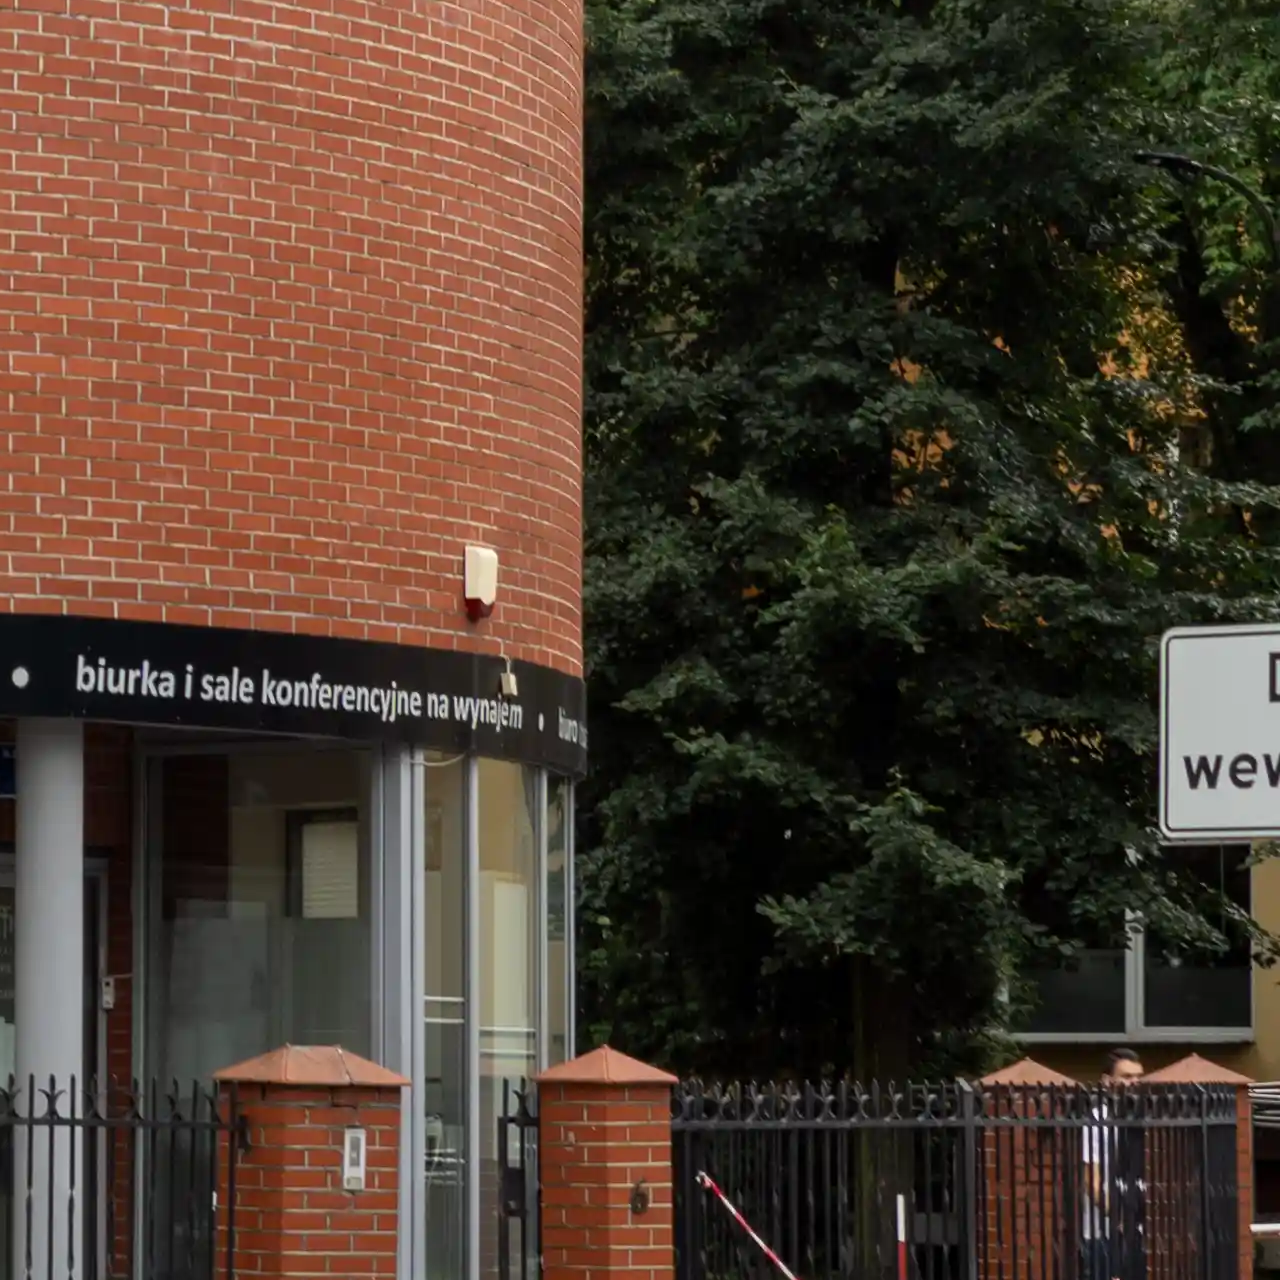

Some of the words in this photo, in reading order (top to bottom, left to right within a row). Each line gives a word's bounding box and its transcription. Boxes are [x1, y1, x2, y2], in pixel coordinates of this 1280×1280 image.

[76, 654, 175, 698] biurka
[184, 664, 194, 700] i
[200, 666, 254, 703] sale
[261, 669, 422, 722] konferencyjne
[427, 692, 449, 719] na
[453, 694, 523, 732] wynajem
